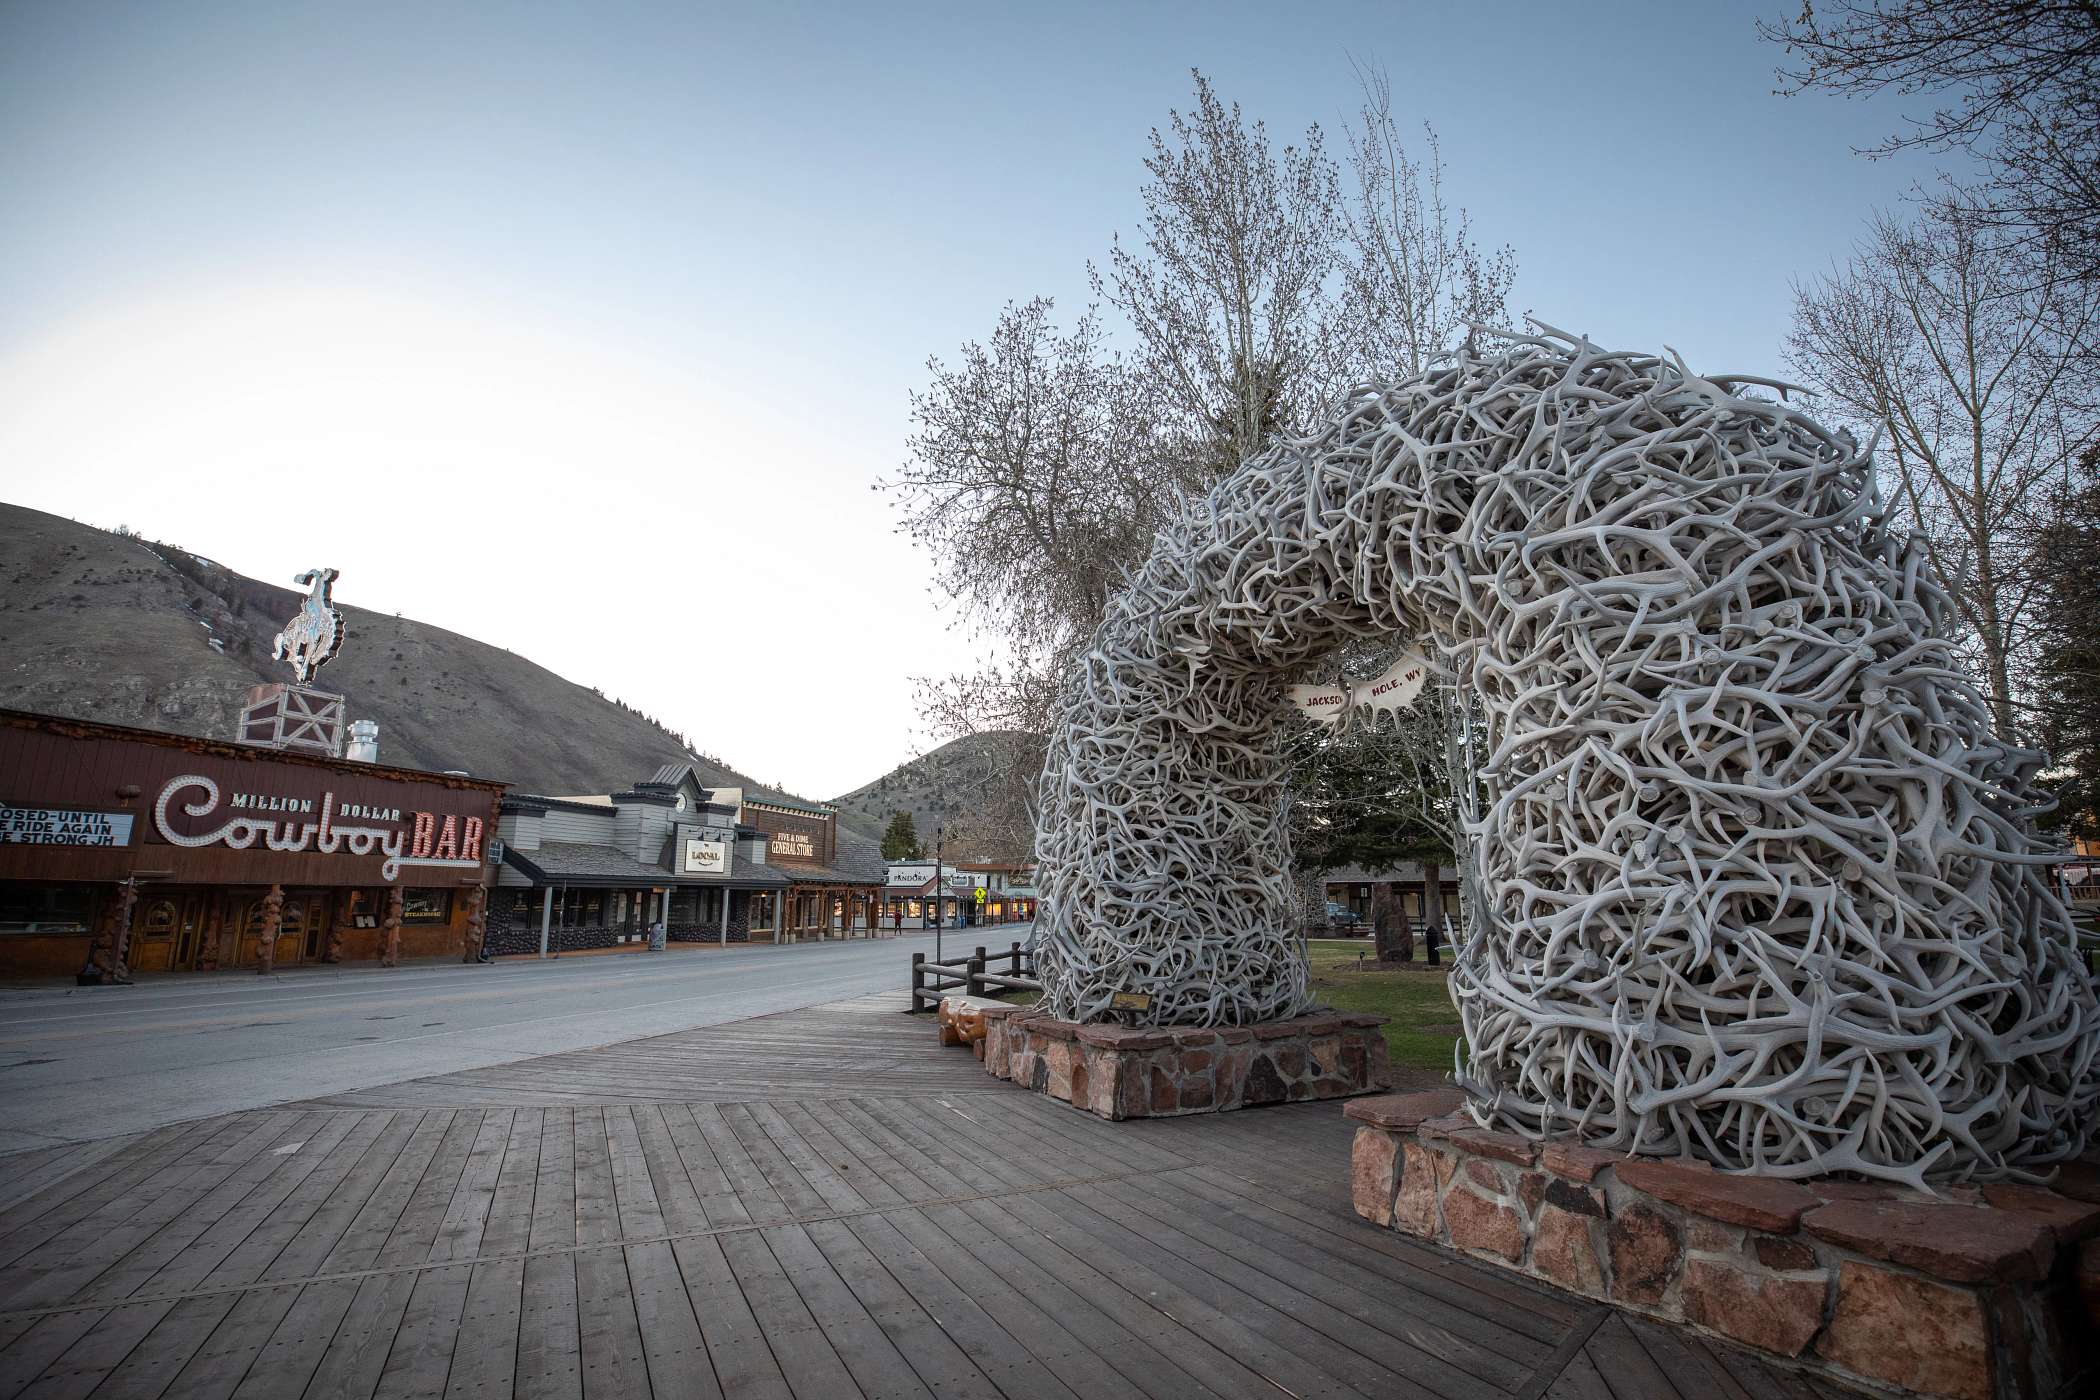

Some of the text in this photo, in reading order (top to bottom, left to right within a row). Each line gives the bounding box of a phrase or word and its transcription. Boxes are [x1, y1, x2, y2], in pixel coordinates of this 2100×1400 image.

[230, 792, 401, 822] MILLION DOLLAR
[13, 820, 55, 833] RIDE
[60, 822, 112, 836] AGAIN
[155, 774, 483, 881] Cowboy BAR
[20, 832, 88, 846] STRONG
[90, 835, 114, 846] JH
[778, 832, 791, 842] FIVE
[692, 851, 721, 861] LOCAL
[771, 840, 814, 857] GENERAL STORE
[893, 873, 927, 882] PANDORA
